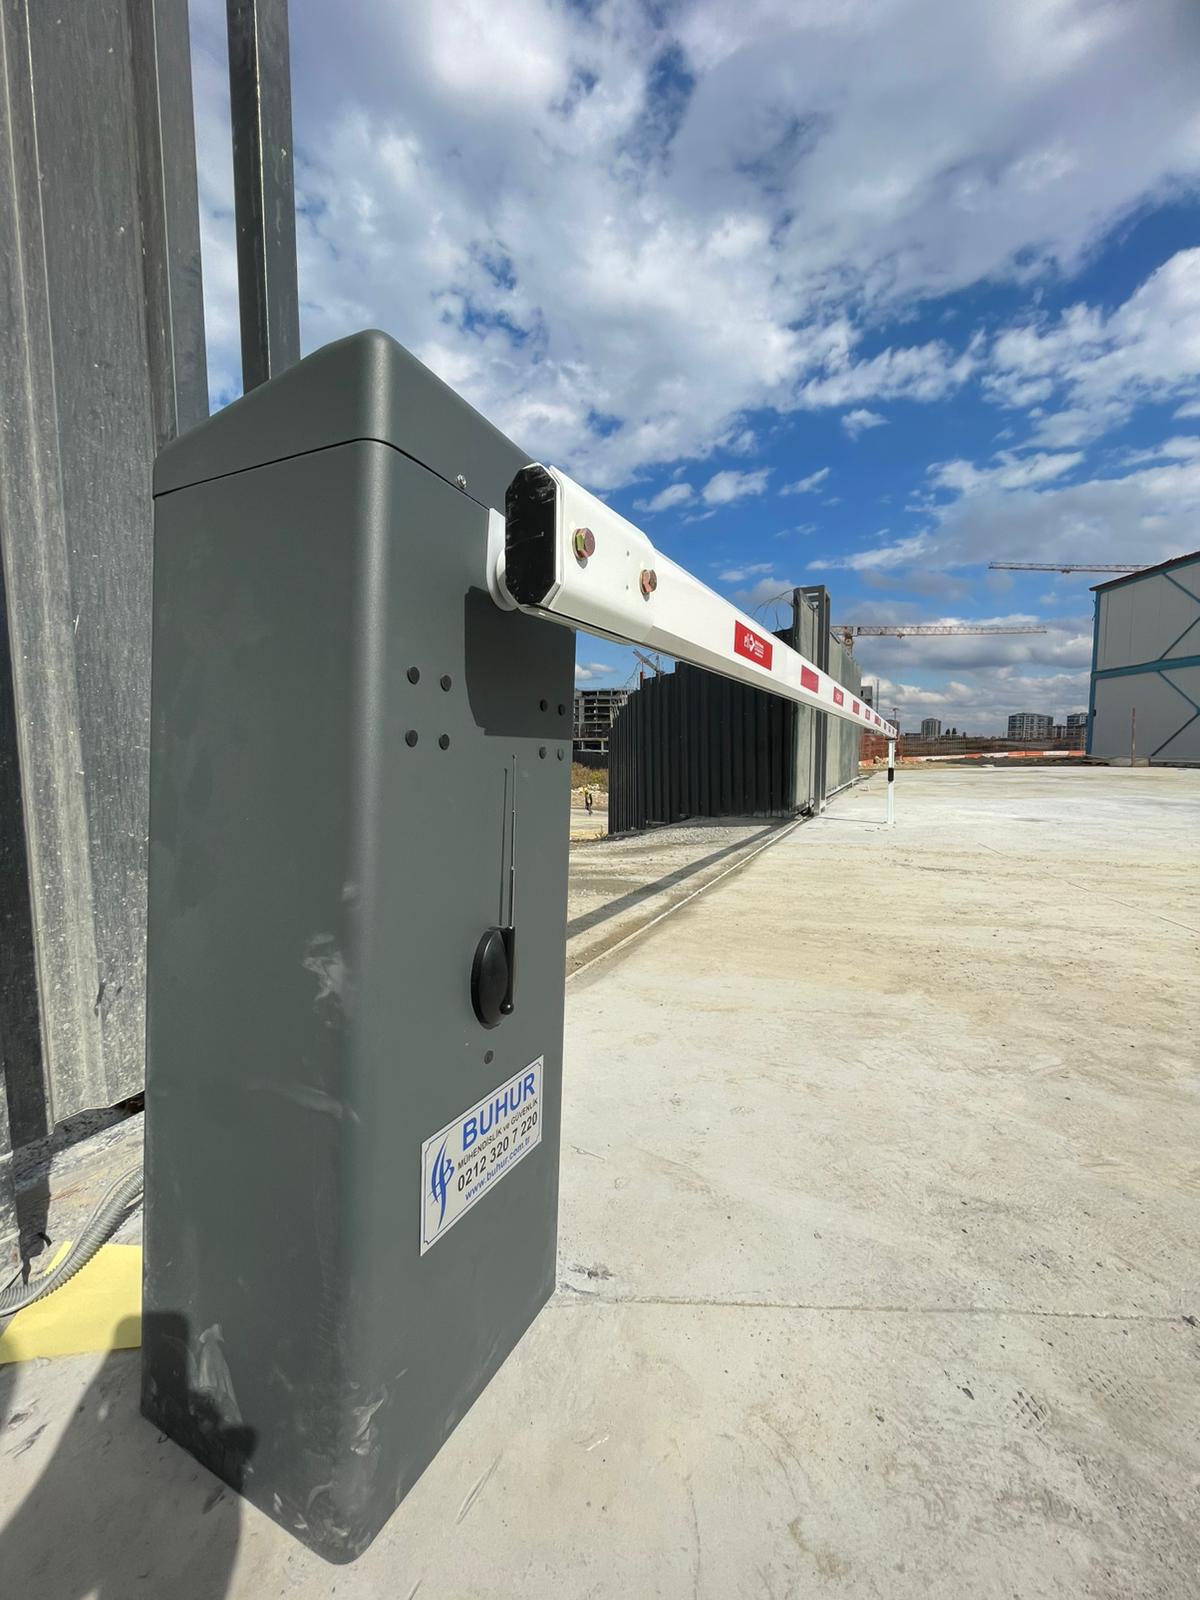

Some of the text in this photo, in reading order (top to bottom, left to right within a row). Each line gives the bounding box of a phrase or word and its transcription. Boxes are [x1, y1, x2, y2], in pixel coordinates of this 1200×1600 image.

[457, 1098, 538, 1170] MÜHENDİSLİK ve GÜVENLİK
[462, 1072, 535, 1151] BUHUR
[458, 1111, 538, 1192] 0212 320 7 220
[465, 1135, 531, 1200] www.buhur.com.tr
